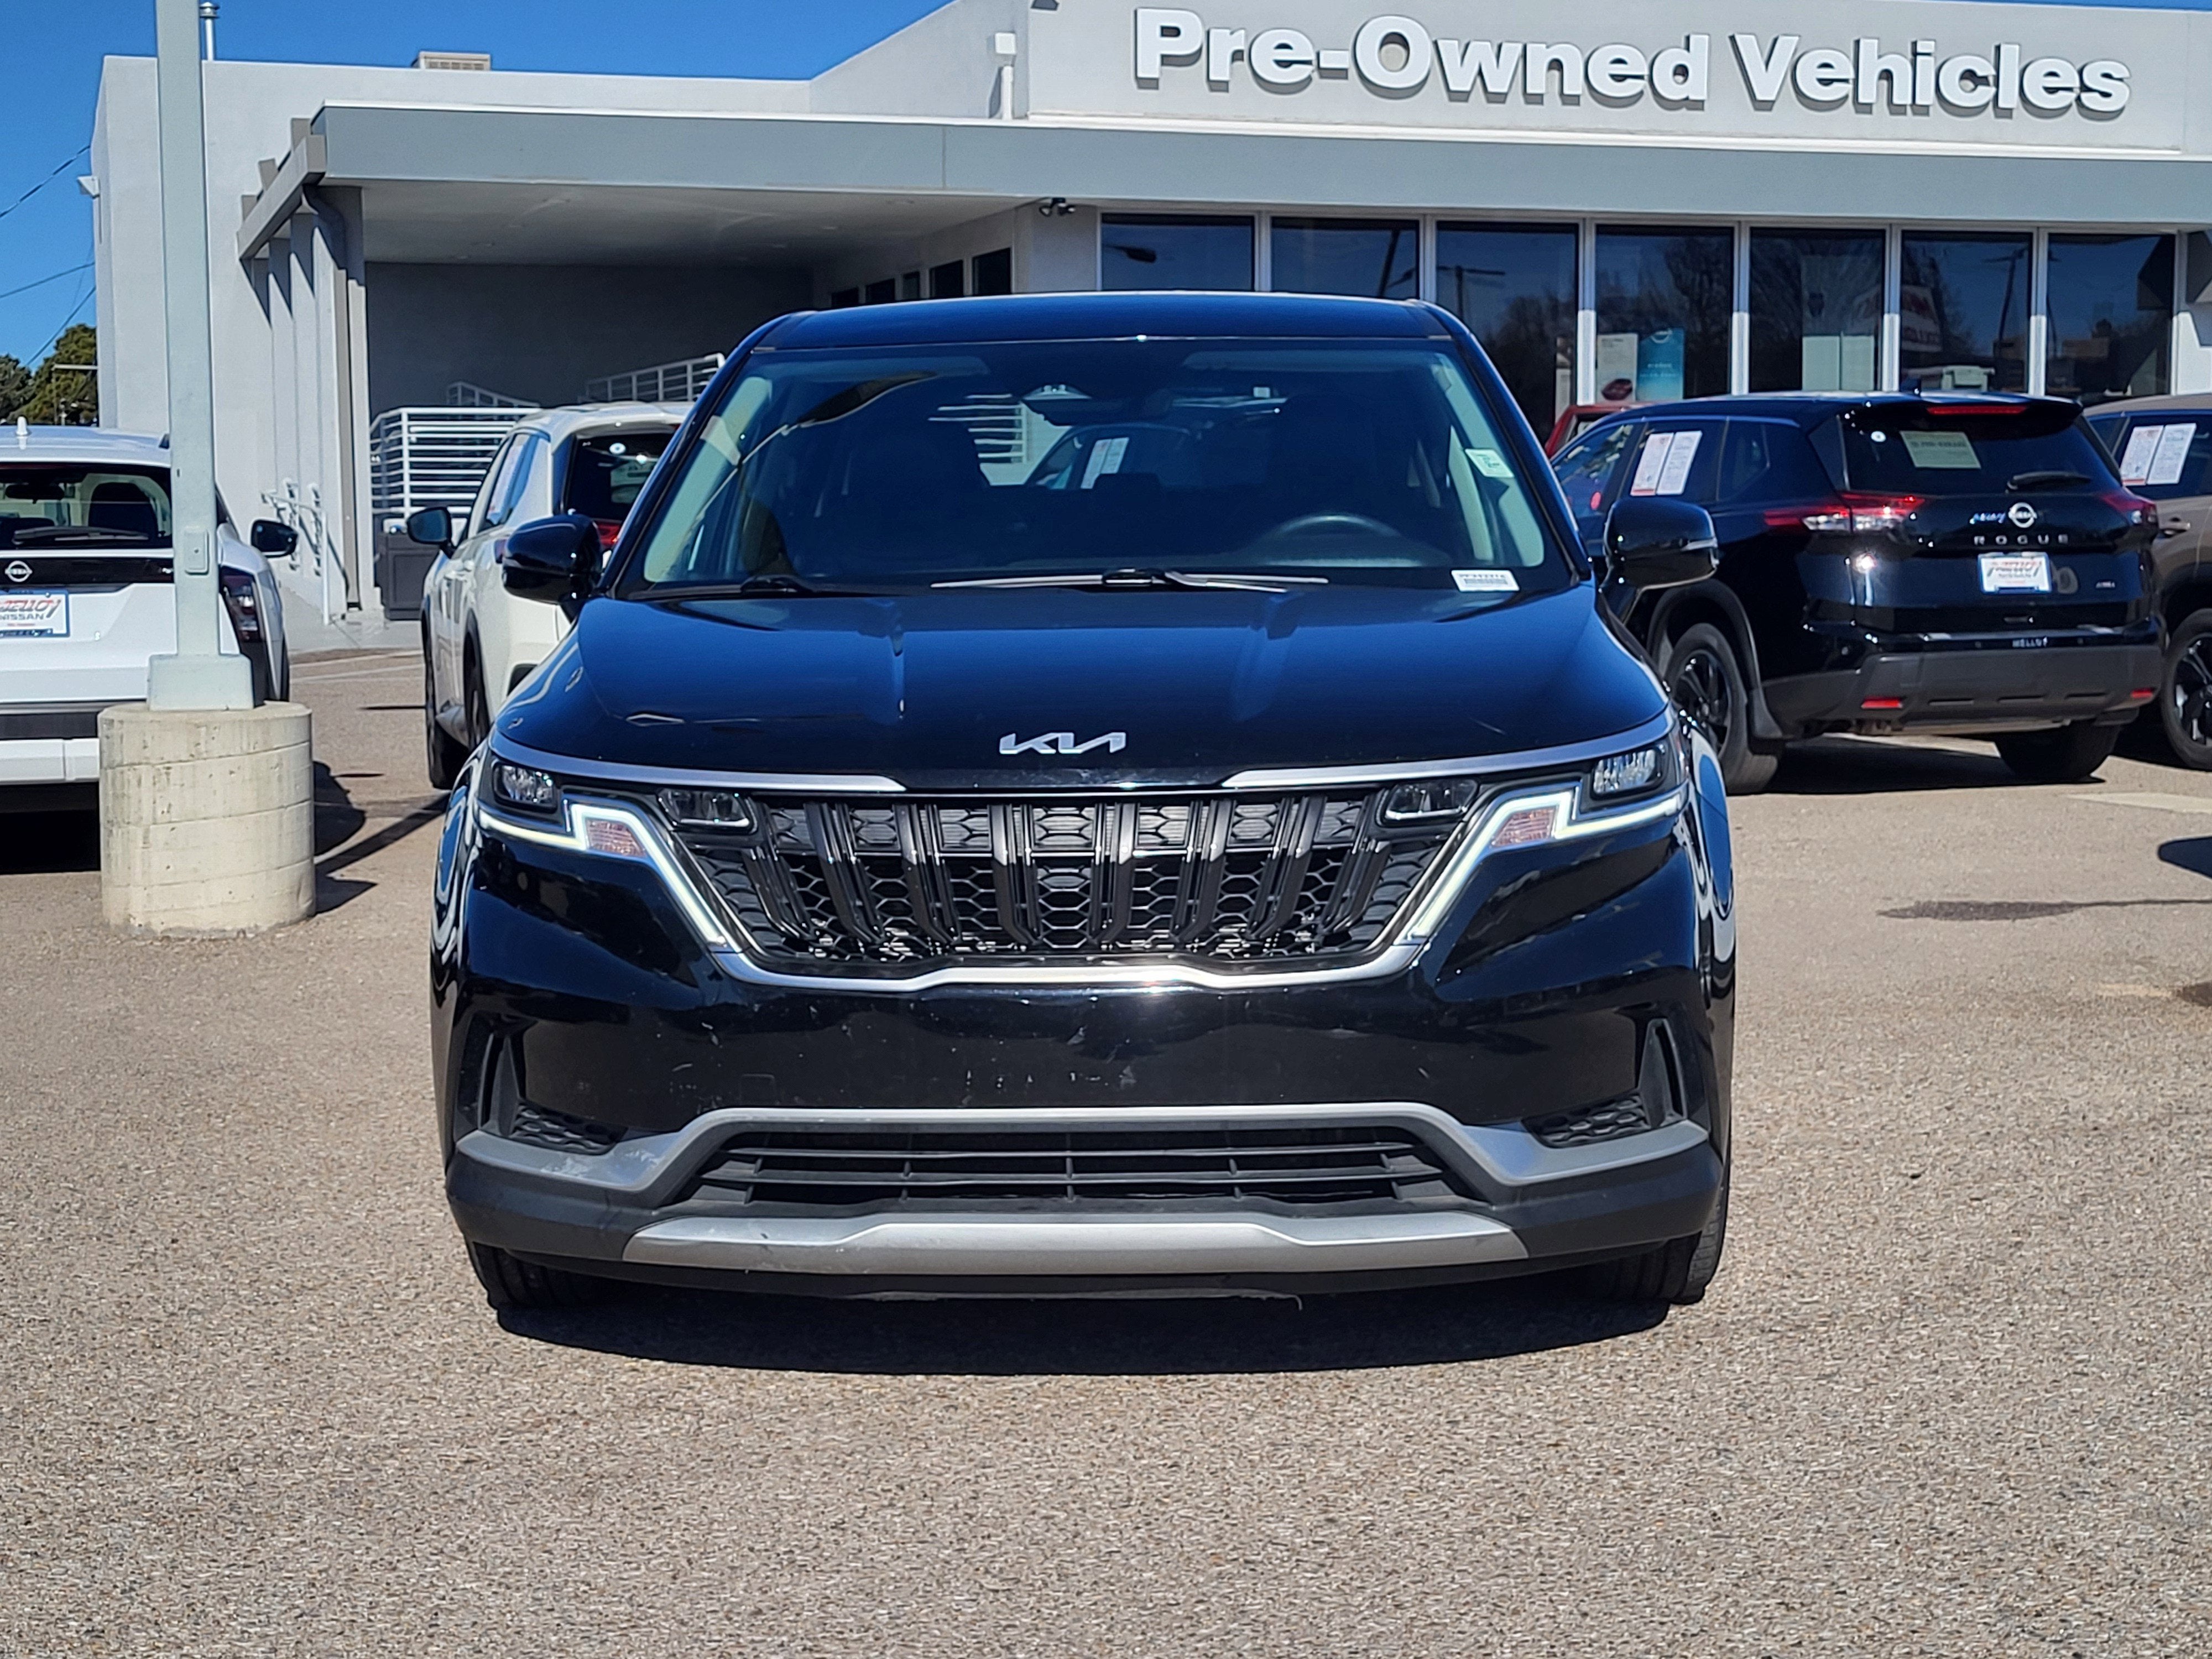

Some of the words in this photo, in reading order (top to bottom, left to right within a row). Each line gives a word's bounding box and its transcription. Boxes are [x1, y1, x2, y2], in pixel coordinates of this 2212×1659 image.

[1136, 8, 1709, 103] Pre-Owned
[1730, 33, 2131, 111] Vehicles
[1974, 534, 2069, 545] ROGUE
